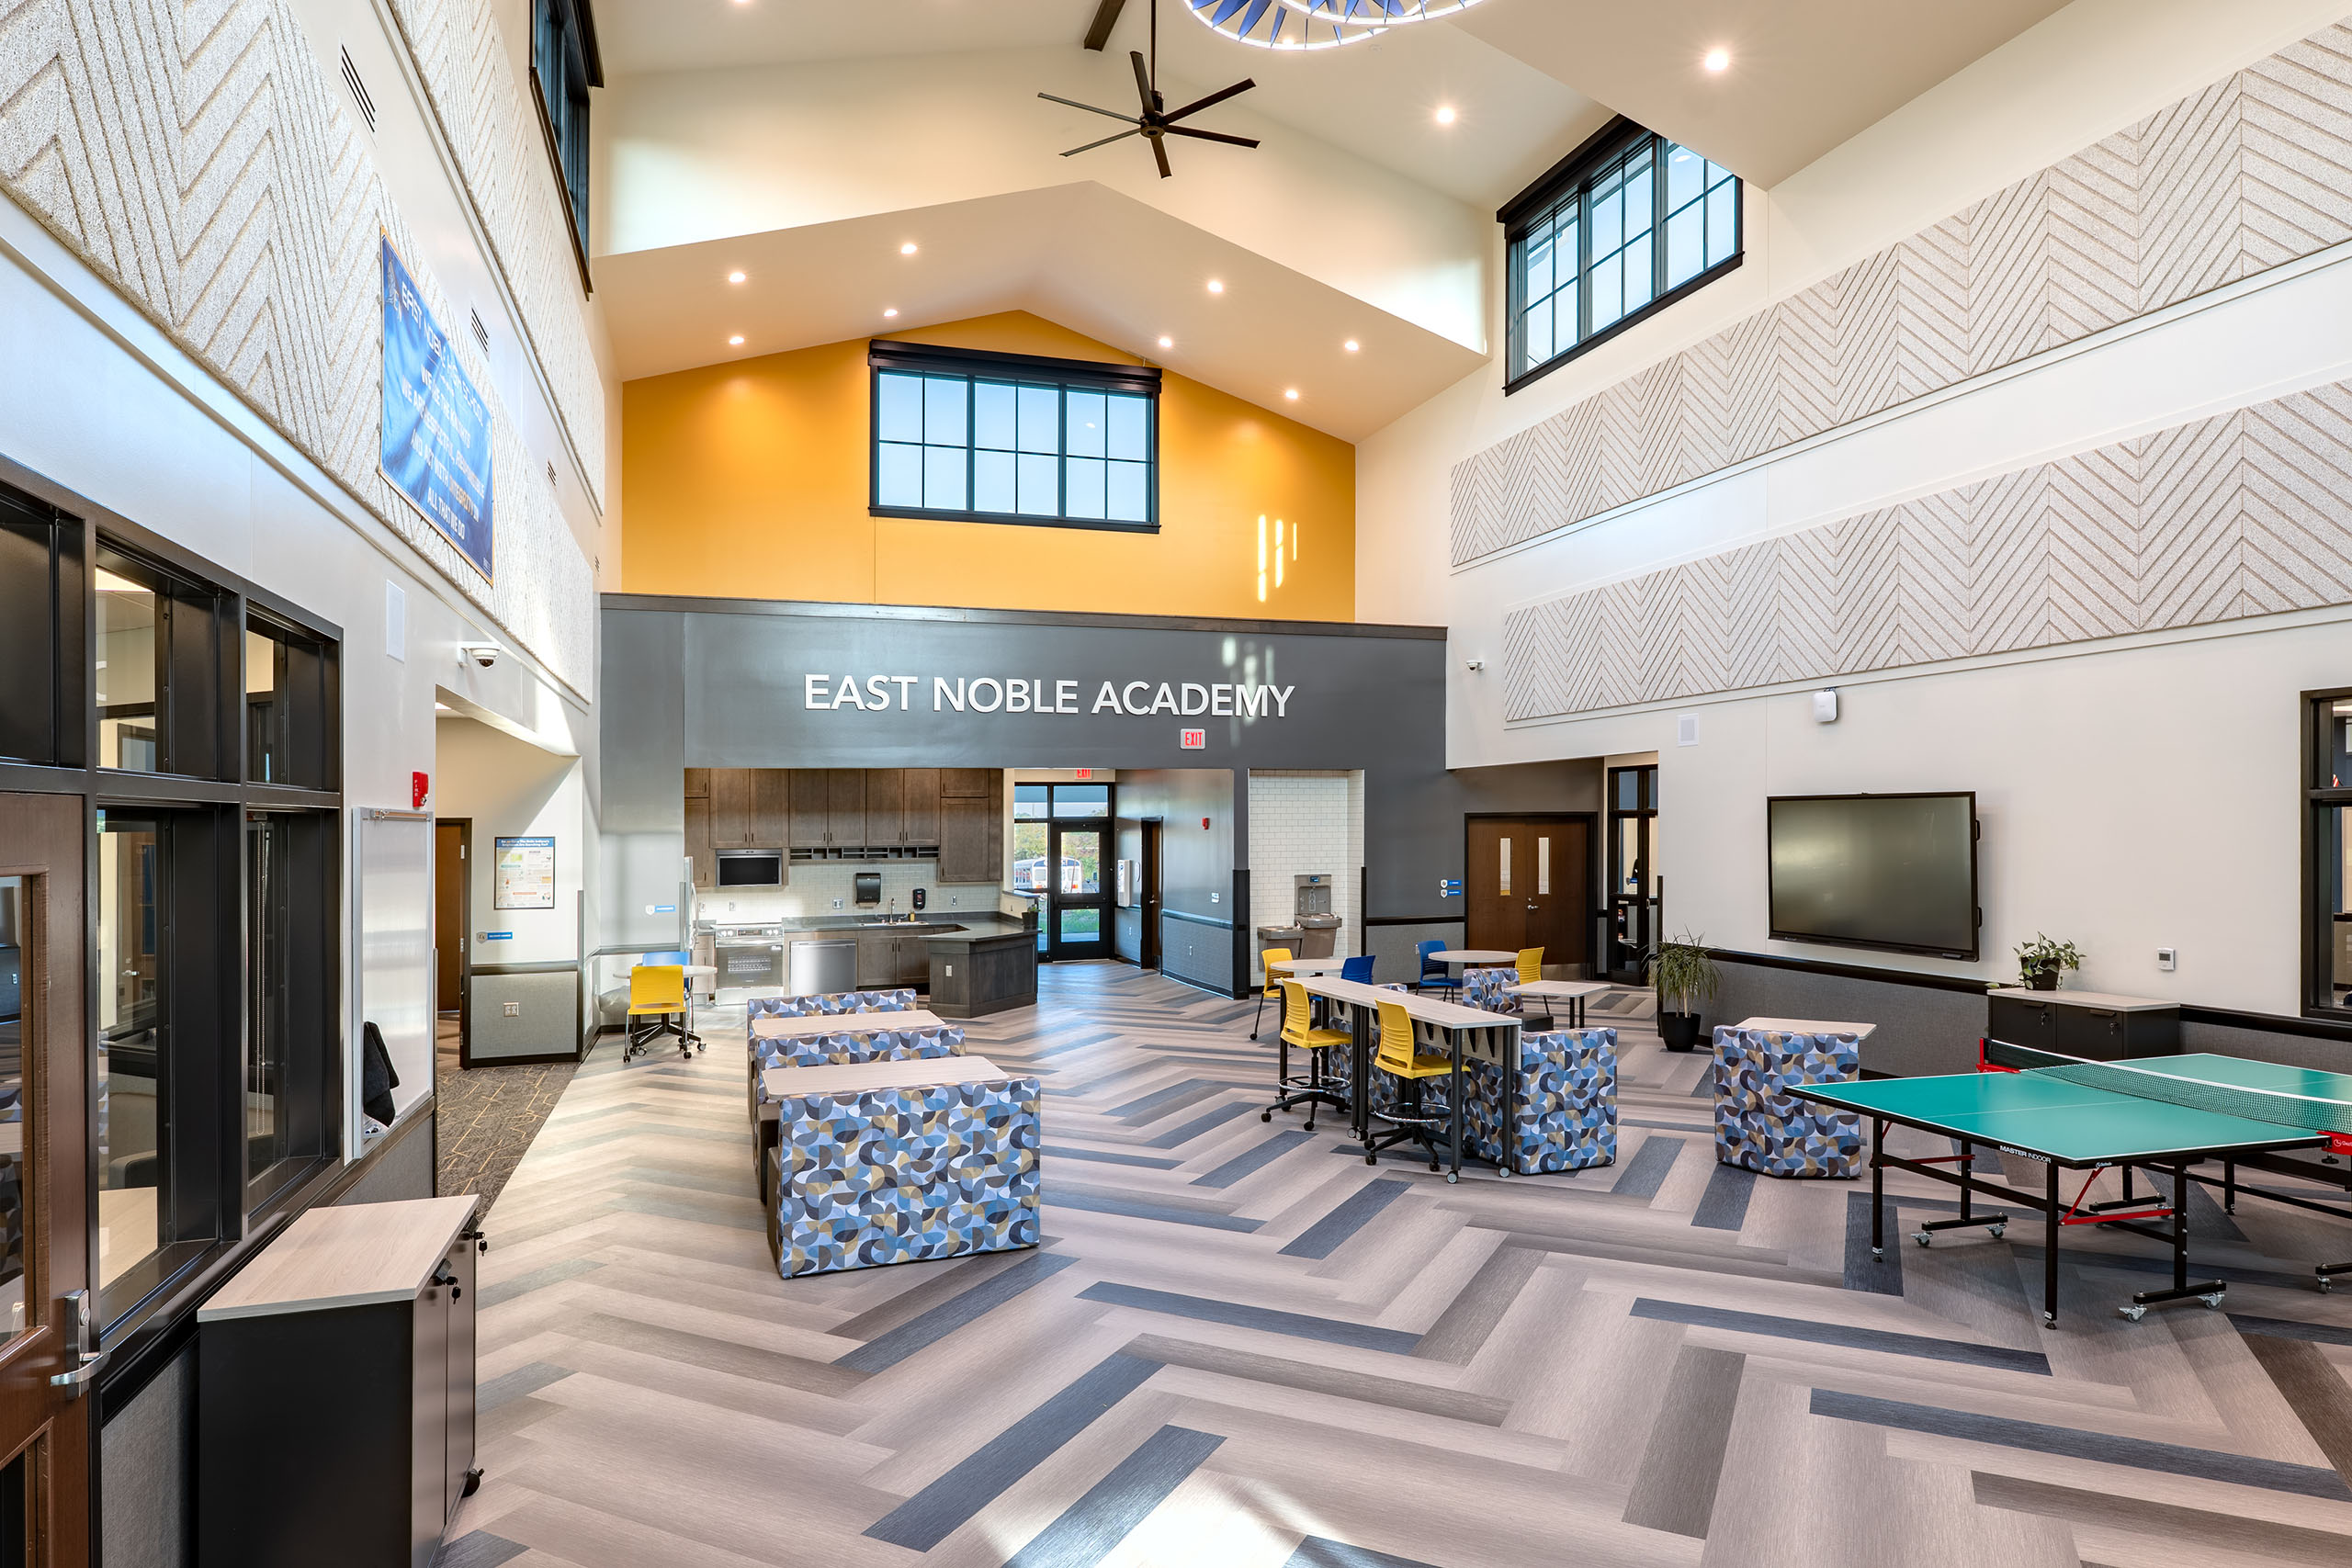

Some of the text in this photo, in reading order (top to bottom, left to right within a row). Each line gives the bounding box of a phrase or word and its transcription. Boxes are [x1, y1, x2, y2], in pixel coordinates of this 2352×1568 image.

[402, 280, 423, 329] EAST
[424, 315, 447, 368] NOBLE
[462, 385, 483, 427] SCHOOL
[402, 374, 412, 403] WE
[421, 363, 432, 390] WE
[411, 428, 422, 456] AND
[435, 458, 448, 488] WITH
[427, 486, 465, 540] ALL THAT WE DO
[805, 673, 1295, 717] EAST NOBLE ACADEMY
[1185, 731, 1203, 746] EXIT
[1999, 1145, 2052, 1164] MASTER INDOOR
